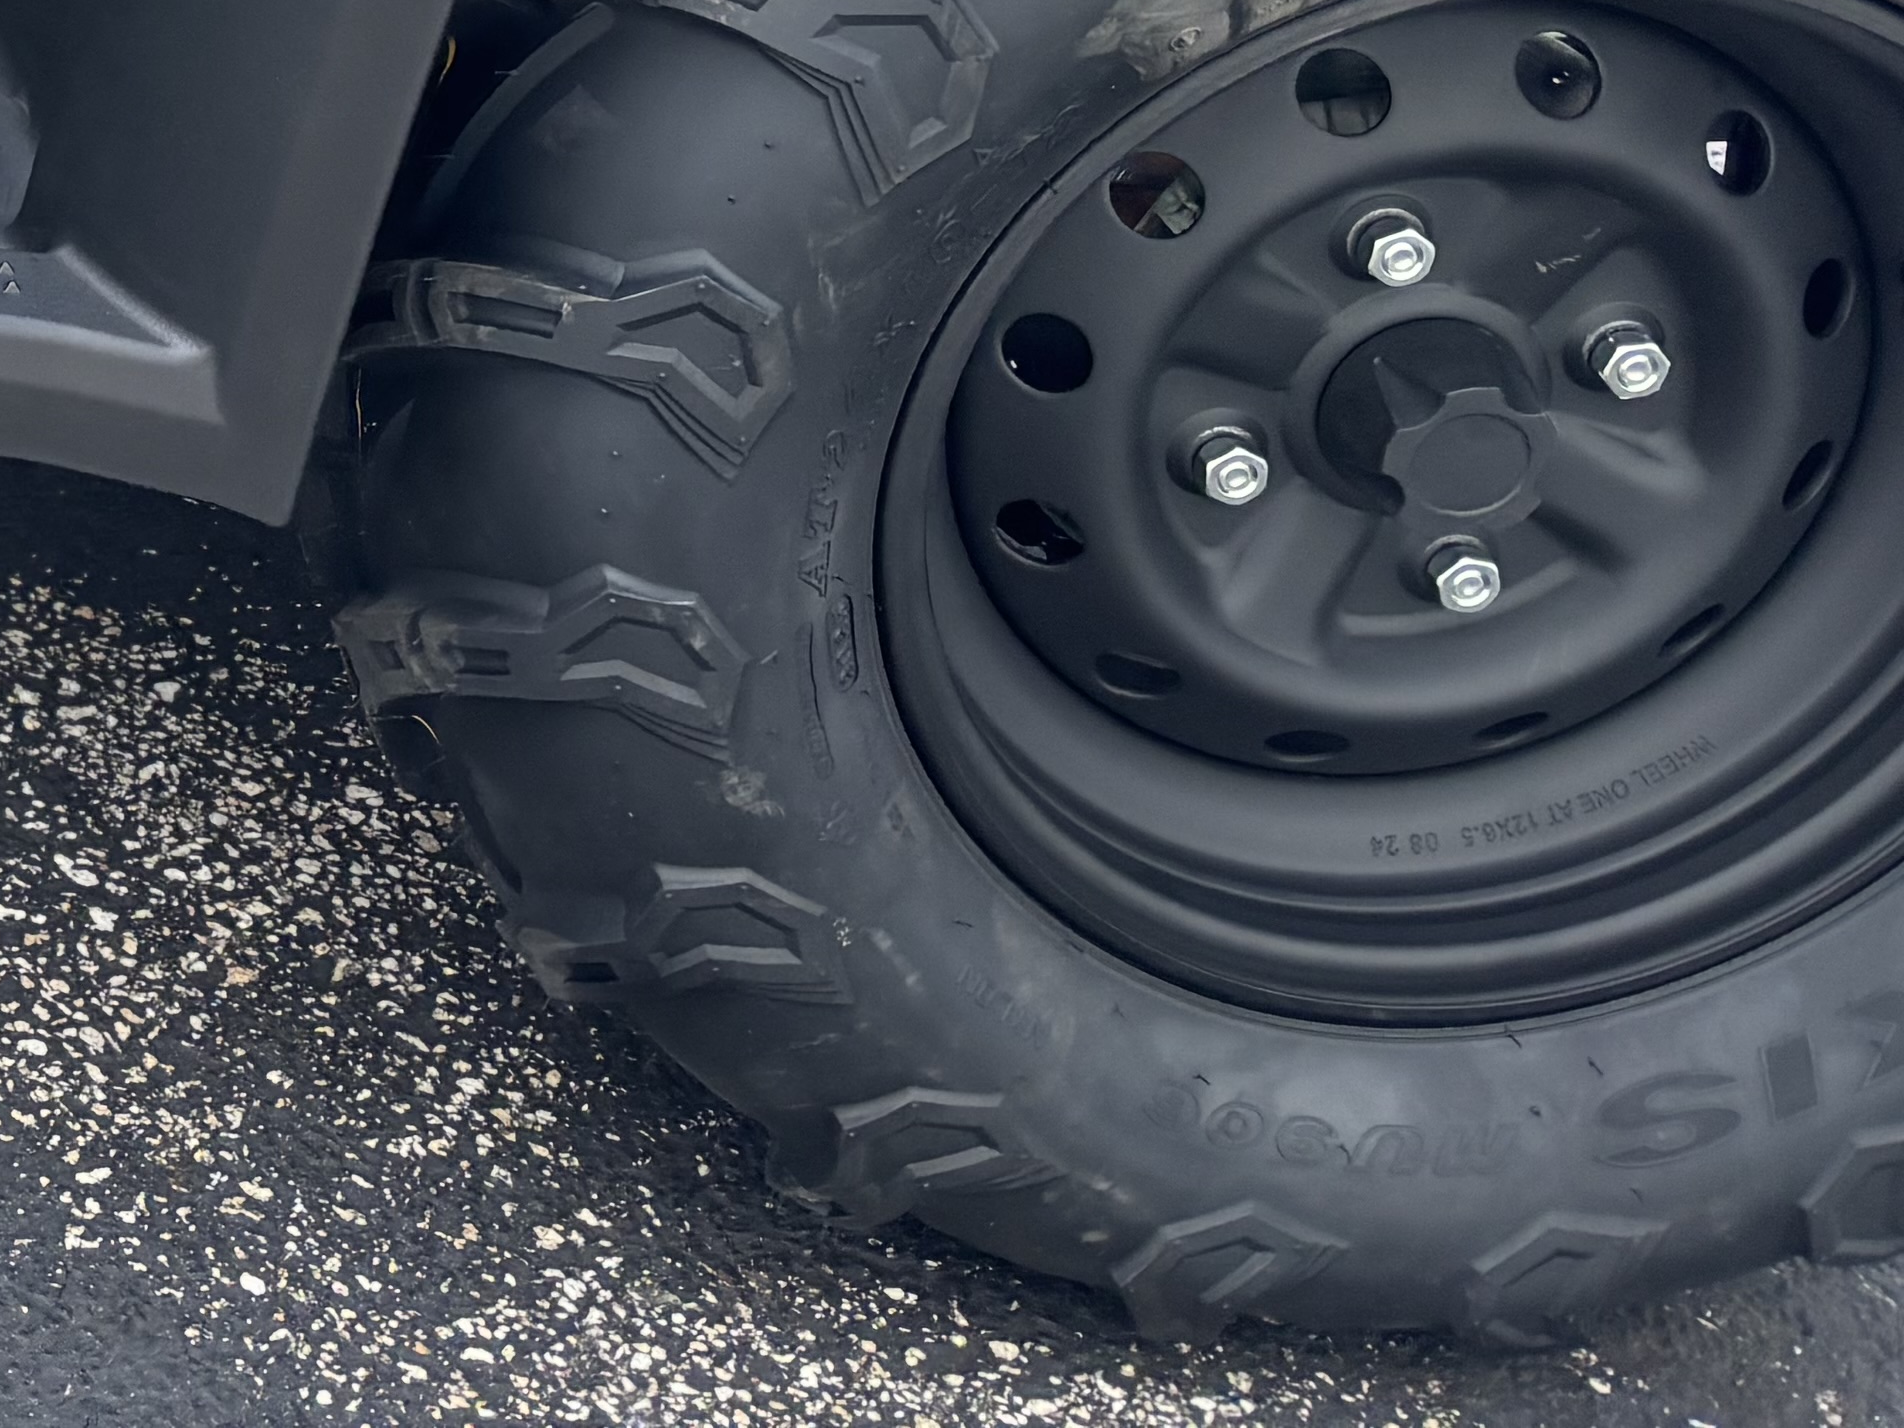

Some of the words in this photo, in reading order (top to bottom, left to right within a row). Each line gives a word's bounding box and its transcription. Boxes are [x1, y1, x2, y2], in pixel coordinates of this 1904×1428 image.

[1630, 733, 1718, 789] WHEEL
[1545, 797, 1574, 828] AT
[1574, 778, 1630, 814] ONE
